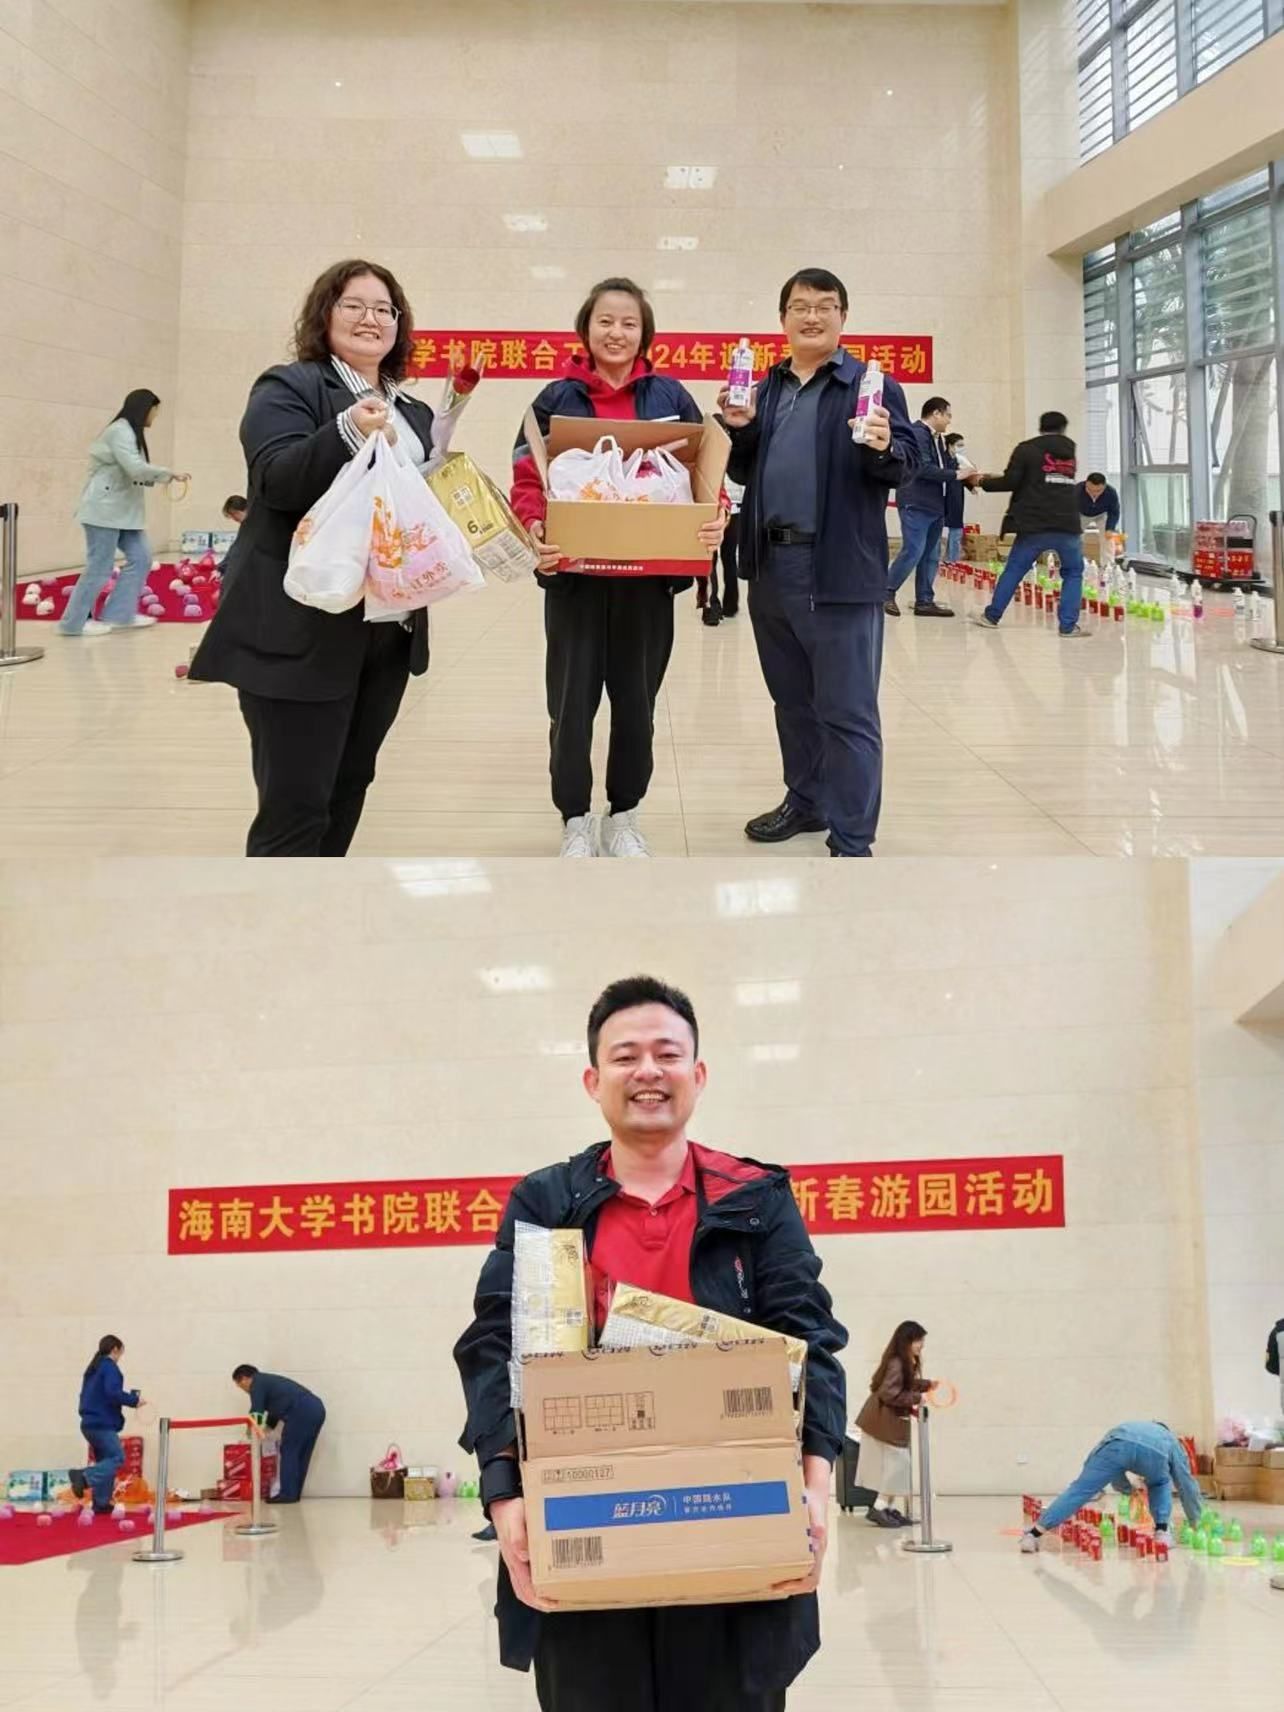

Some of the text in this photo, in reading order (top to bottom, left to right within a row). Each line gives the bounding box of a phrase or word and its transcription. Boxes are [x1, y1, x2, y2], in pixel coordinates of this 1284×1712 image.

[178, 1168, 1053, 1242] 海南大学书院联合 新春游园活动
